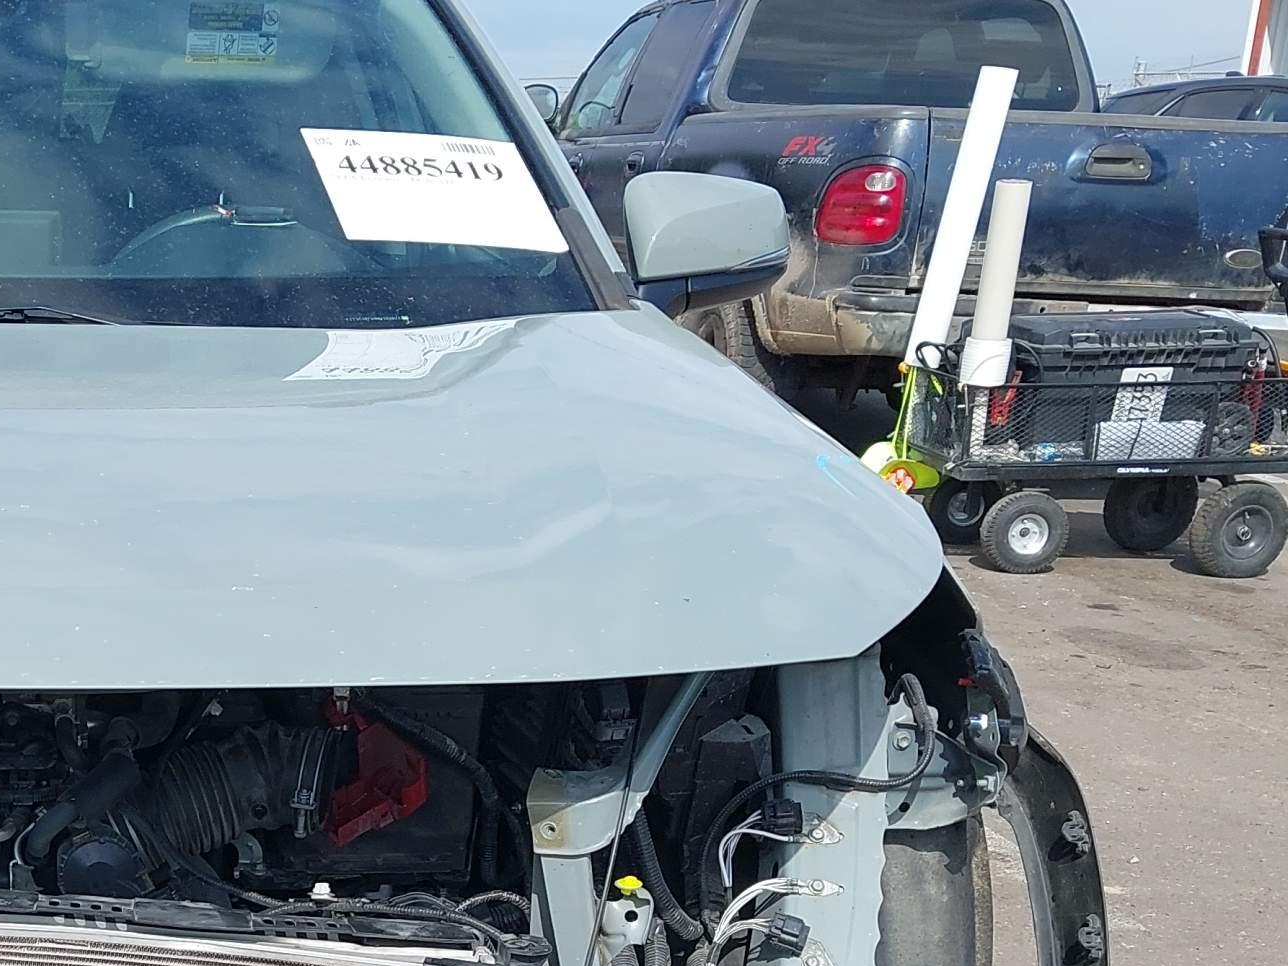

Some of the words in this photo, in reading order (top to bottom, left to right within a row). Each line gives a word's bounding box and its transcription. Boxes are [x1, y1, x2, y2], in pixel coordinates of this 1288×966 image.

[781, 135, 837, 157] FX4
[338, 154, 504, 182] 44885419
[777, 157, 797, 165] OFF
